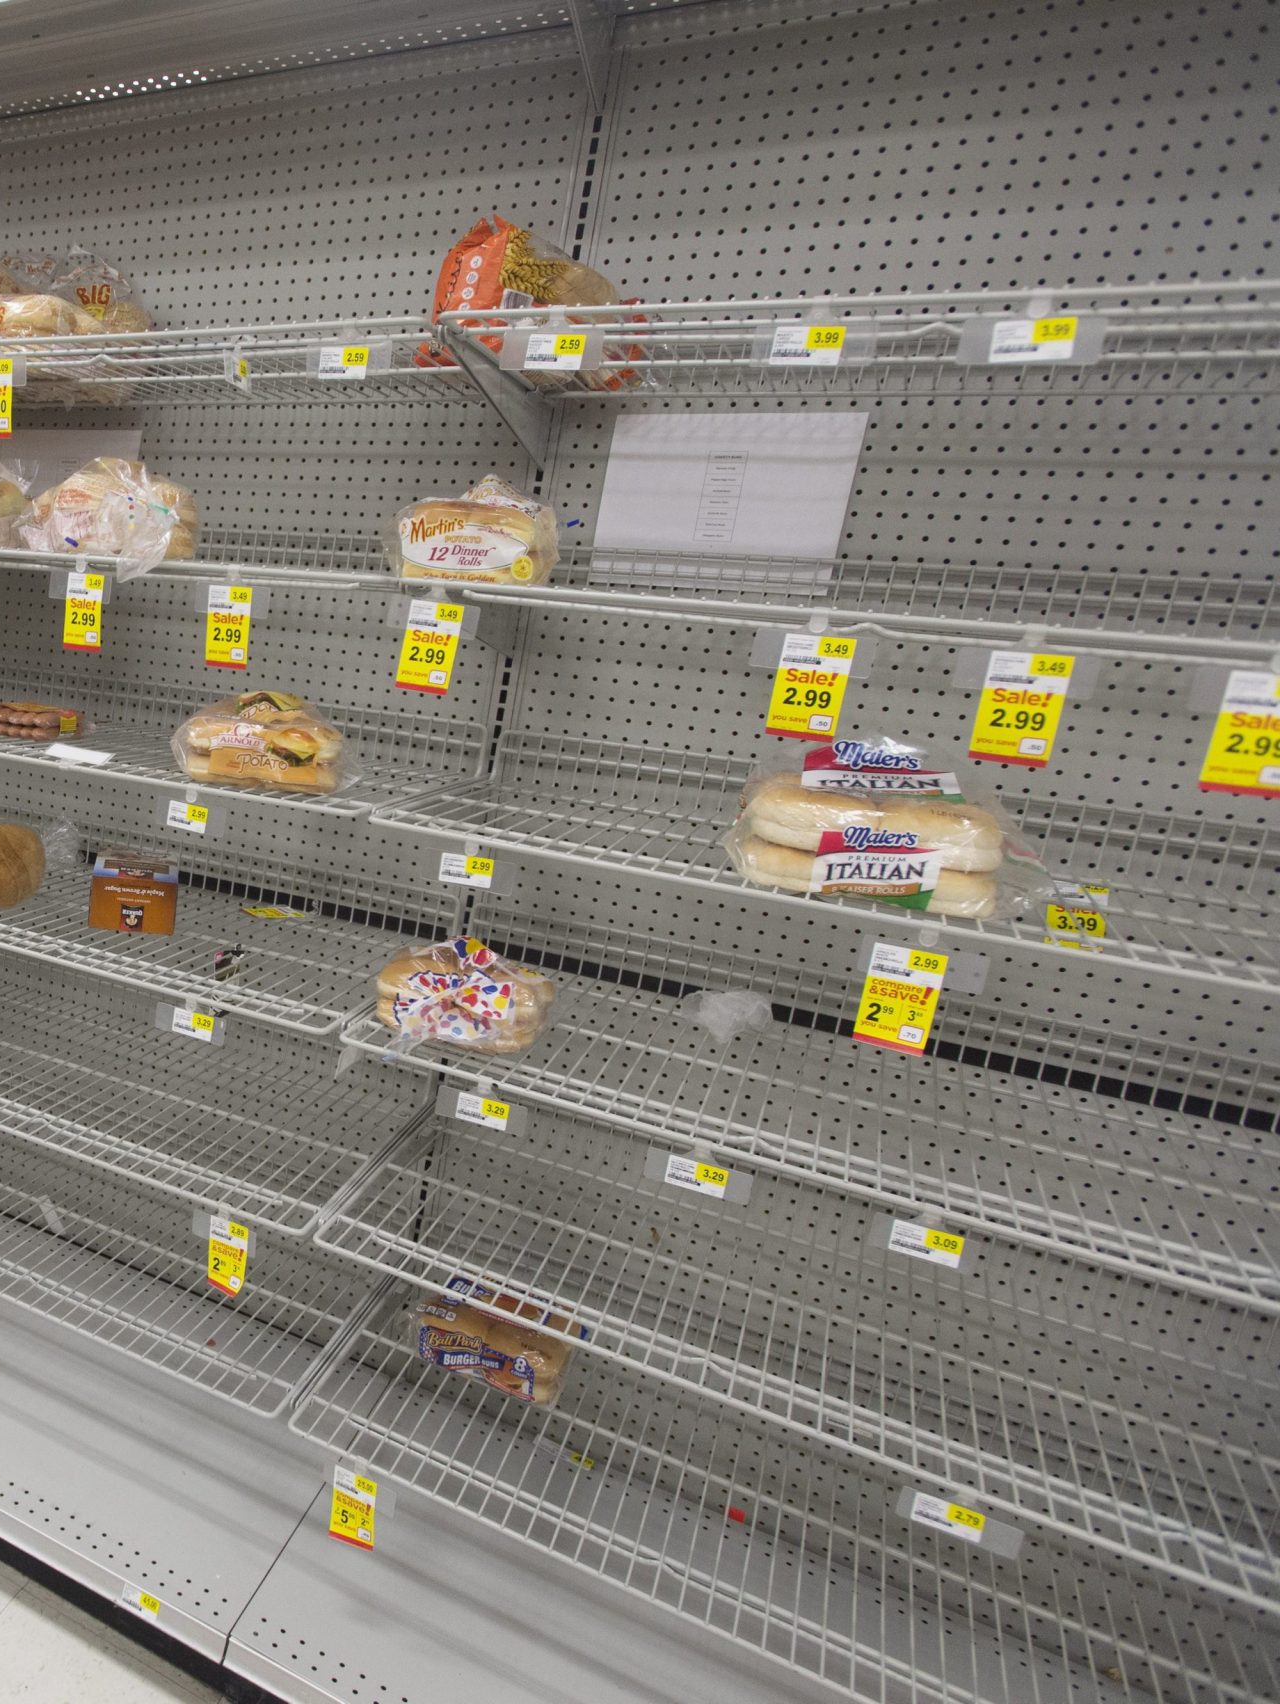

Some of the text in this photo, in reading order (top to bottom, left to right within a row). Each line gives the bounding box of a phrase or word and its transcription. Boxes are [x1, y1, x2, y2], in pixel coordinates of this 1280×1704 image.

[76, 284, 112, 305] BIG
[560, 339, 581, 350] 2.59
[814, 332, 840, 344] 3.99
[347, 352, 365, 363] 2.59
[410, 517, 465, 545] Martin's
[427, 544, 496, 562] 12 Dinner
[457, 556, 483, 567] Rolls
[232, 591, 248, 601] 3.49
[70, 597, 97, 611] Sale!
[71, 611, 96, 627] 2.99
[213, 611, 245, 626] Sale!
[439, 608, 458, 619] 3.49
[213, 627, 242, 644] 2.99
[412, 629, 452, 647] Sale!
[409, 645, 446, 665] 2.99
[824, 643, 849, 655] 3.49
[1037, 660, 1066, 673] 3.49
[785, 667, 839, 688] Sale!
[783, 687, 832, 709] 2.99
[991, 687, 1054, 708] Sale!
[989, 708, 1046, 732] 2.99
[219, 735, 261, 747] ARNOLD
[995, 739, 1018, 747] save
[834, 741, 920, 769] Maier's
[817, 778, 941, 790] ITALIAN
[842, 773, 914, 781] PREMIUM
[191, 809, 206, 820] 2.99
[844, 826, 919, 849] Maier's
[472, 860, 491, 871] 2.99
[823, 860, 927, 882] ITALIAN
[878, 886, 906, 895] ROLLS
[122, 908, 144, 917] QUAKER
[913, 956, 939, 970] 2.99
[871, 978, 923, 993] compare
[869, 985, 934, 1006] &save!
[196, 1017, 211, 1028] 3.29
[879, 1023, 898, 1032] save
[903, 1031, 917, 1039] .70
[486, 1103, 505, 1116] 3.29
[703, 1168, 725, 1182] 3.29
[231, 1226, 245, 1237] 2.89
[932, 1235, 958, 1250] 3.09
[428, 1331, 481, 1349] Ball Park
[443, 1353, 500, 1369] BURGER BUNS
[513, 1357, 528, 1373] 8
[954, 1510, 980, 1526] 2.79
